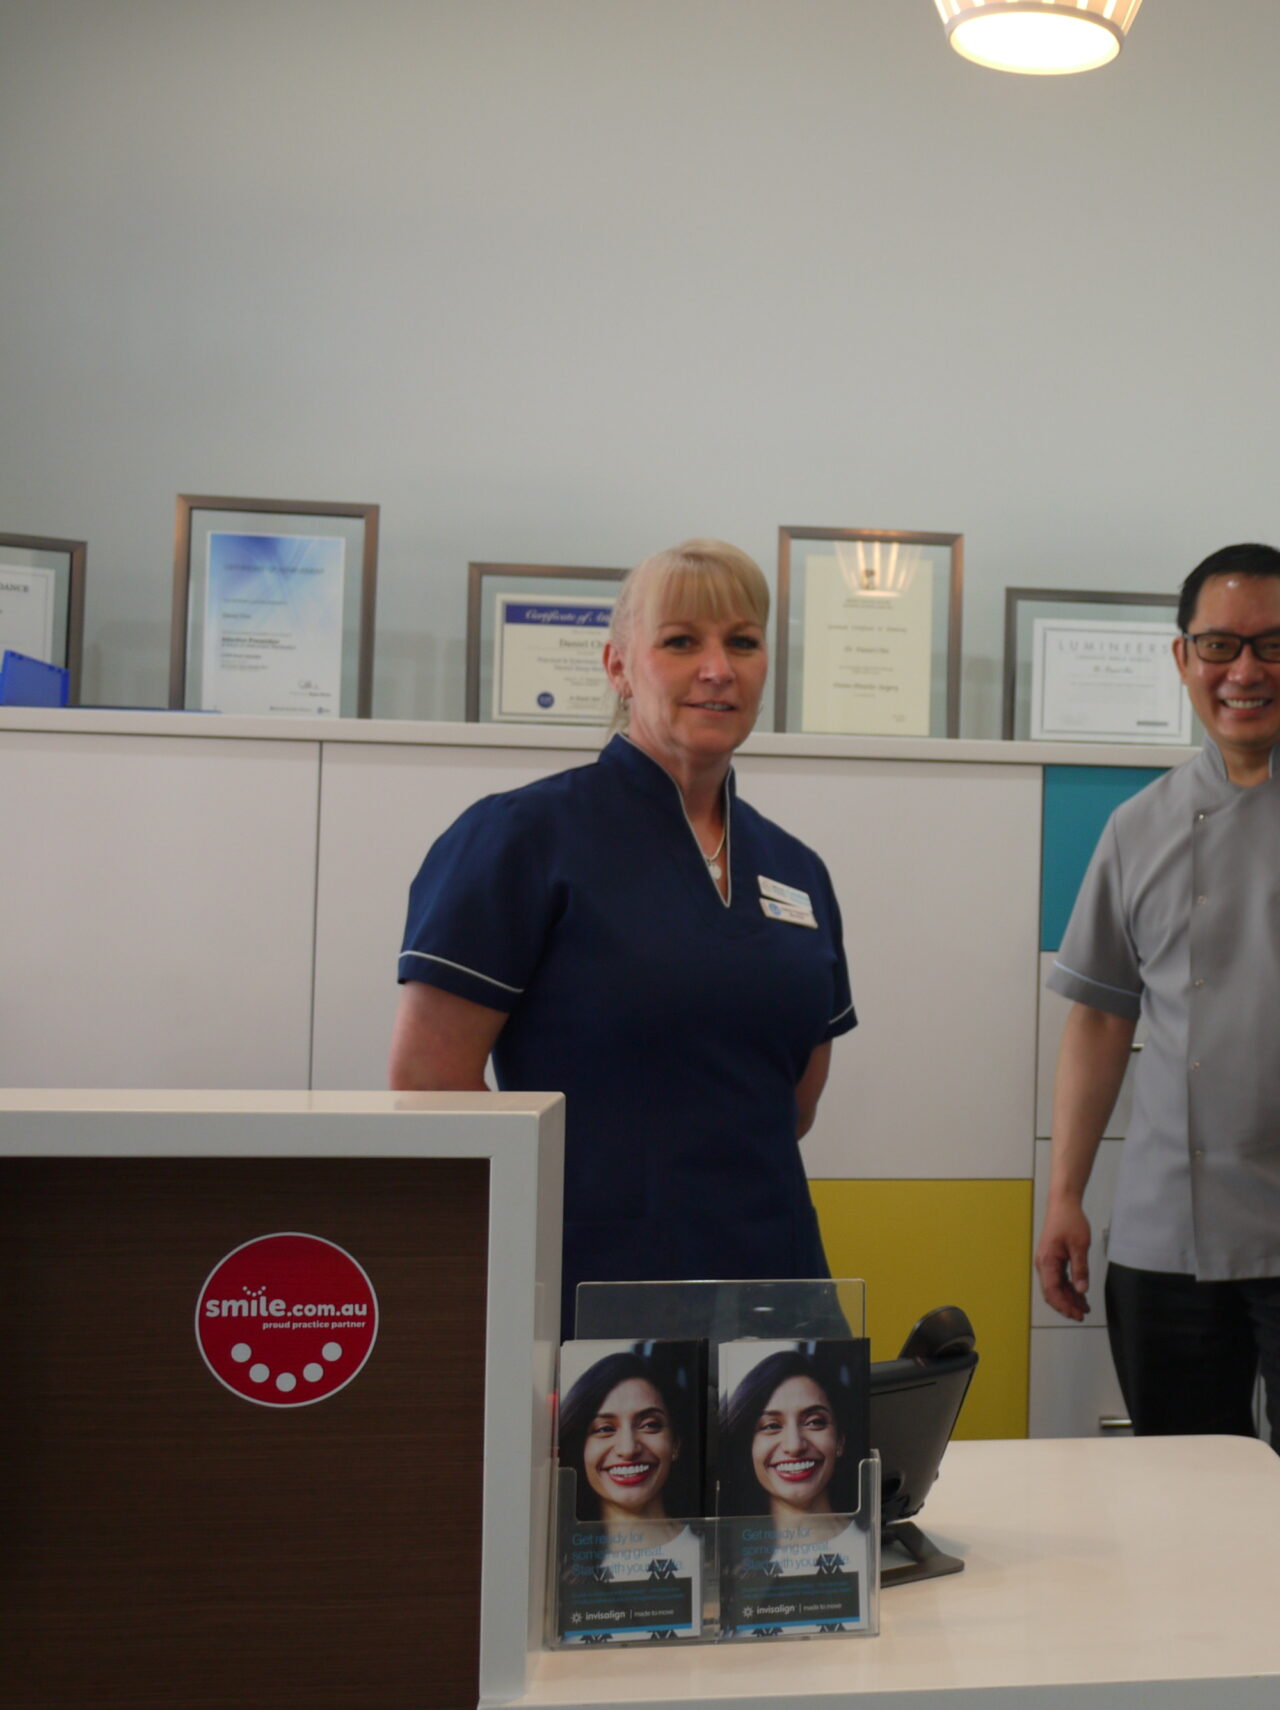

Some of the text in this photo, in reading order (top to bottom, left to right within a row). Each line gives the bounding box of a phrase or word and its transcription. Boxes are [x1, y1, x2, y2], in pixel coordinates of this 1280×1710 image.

[206, 1290, 368, 1318] smile.com.au
[263, 1320, 367, 1331] proud practice partner
[572, 1532, 594, 1546] Get
[630, 1530, 646, 1543] for
[797, 1526, 813, 1538] for
[585, 1609, 626, 1621] invisalign
[756, 1603, 795, 1616] invisalign
